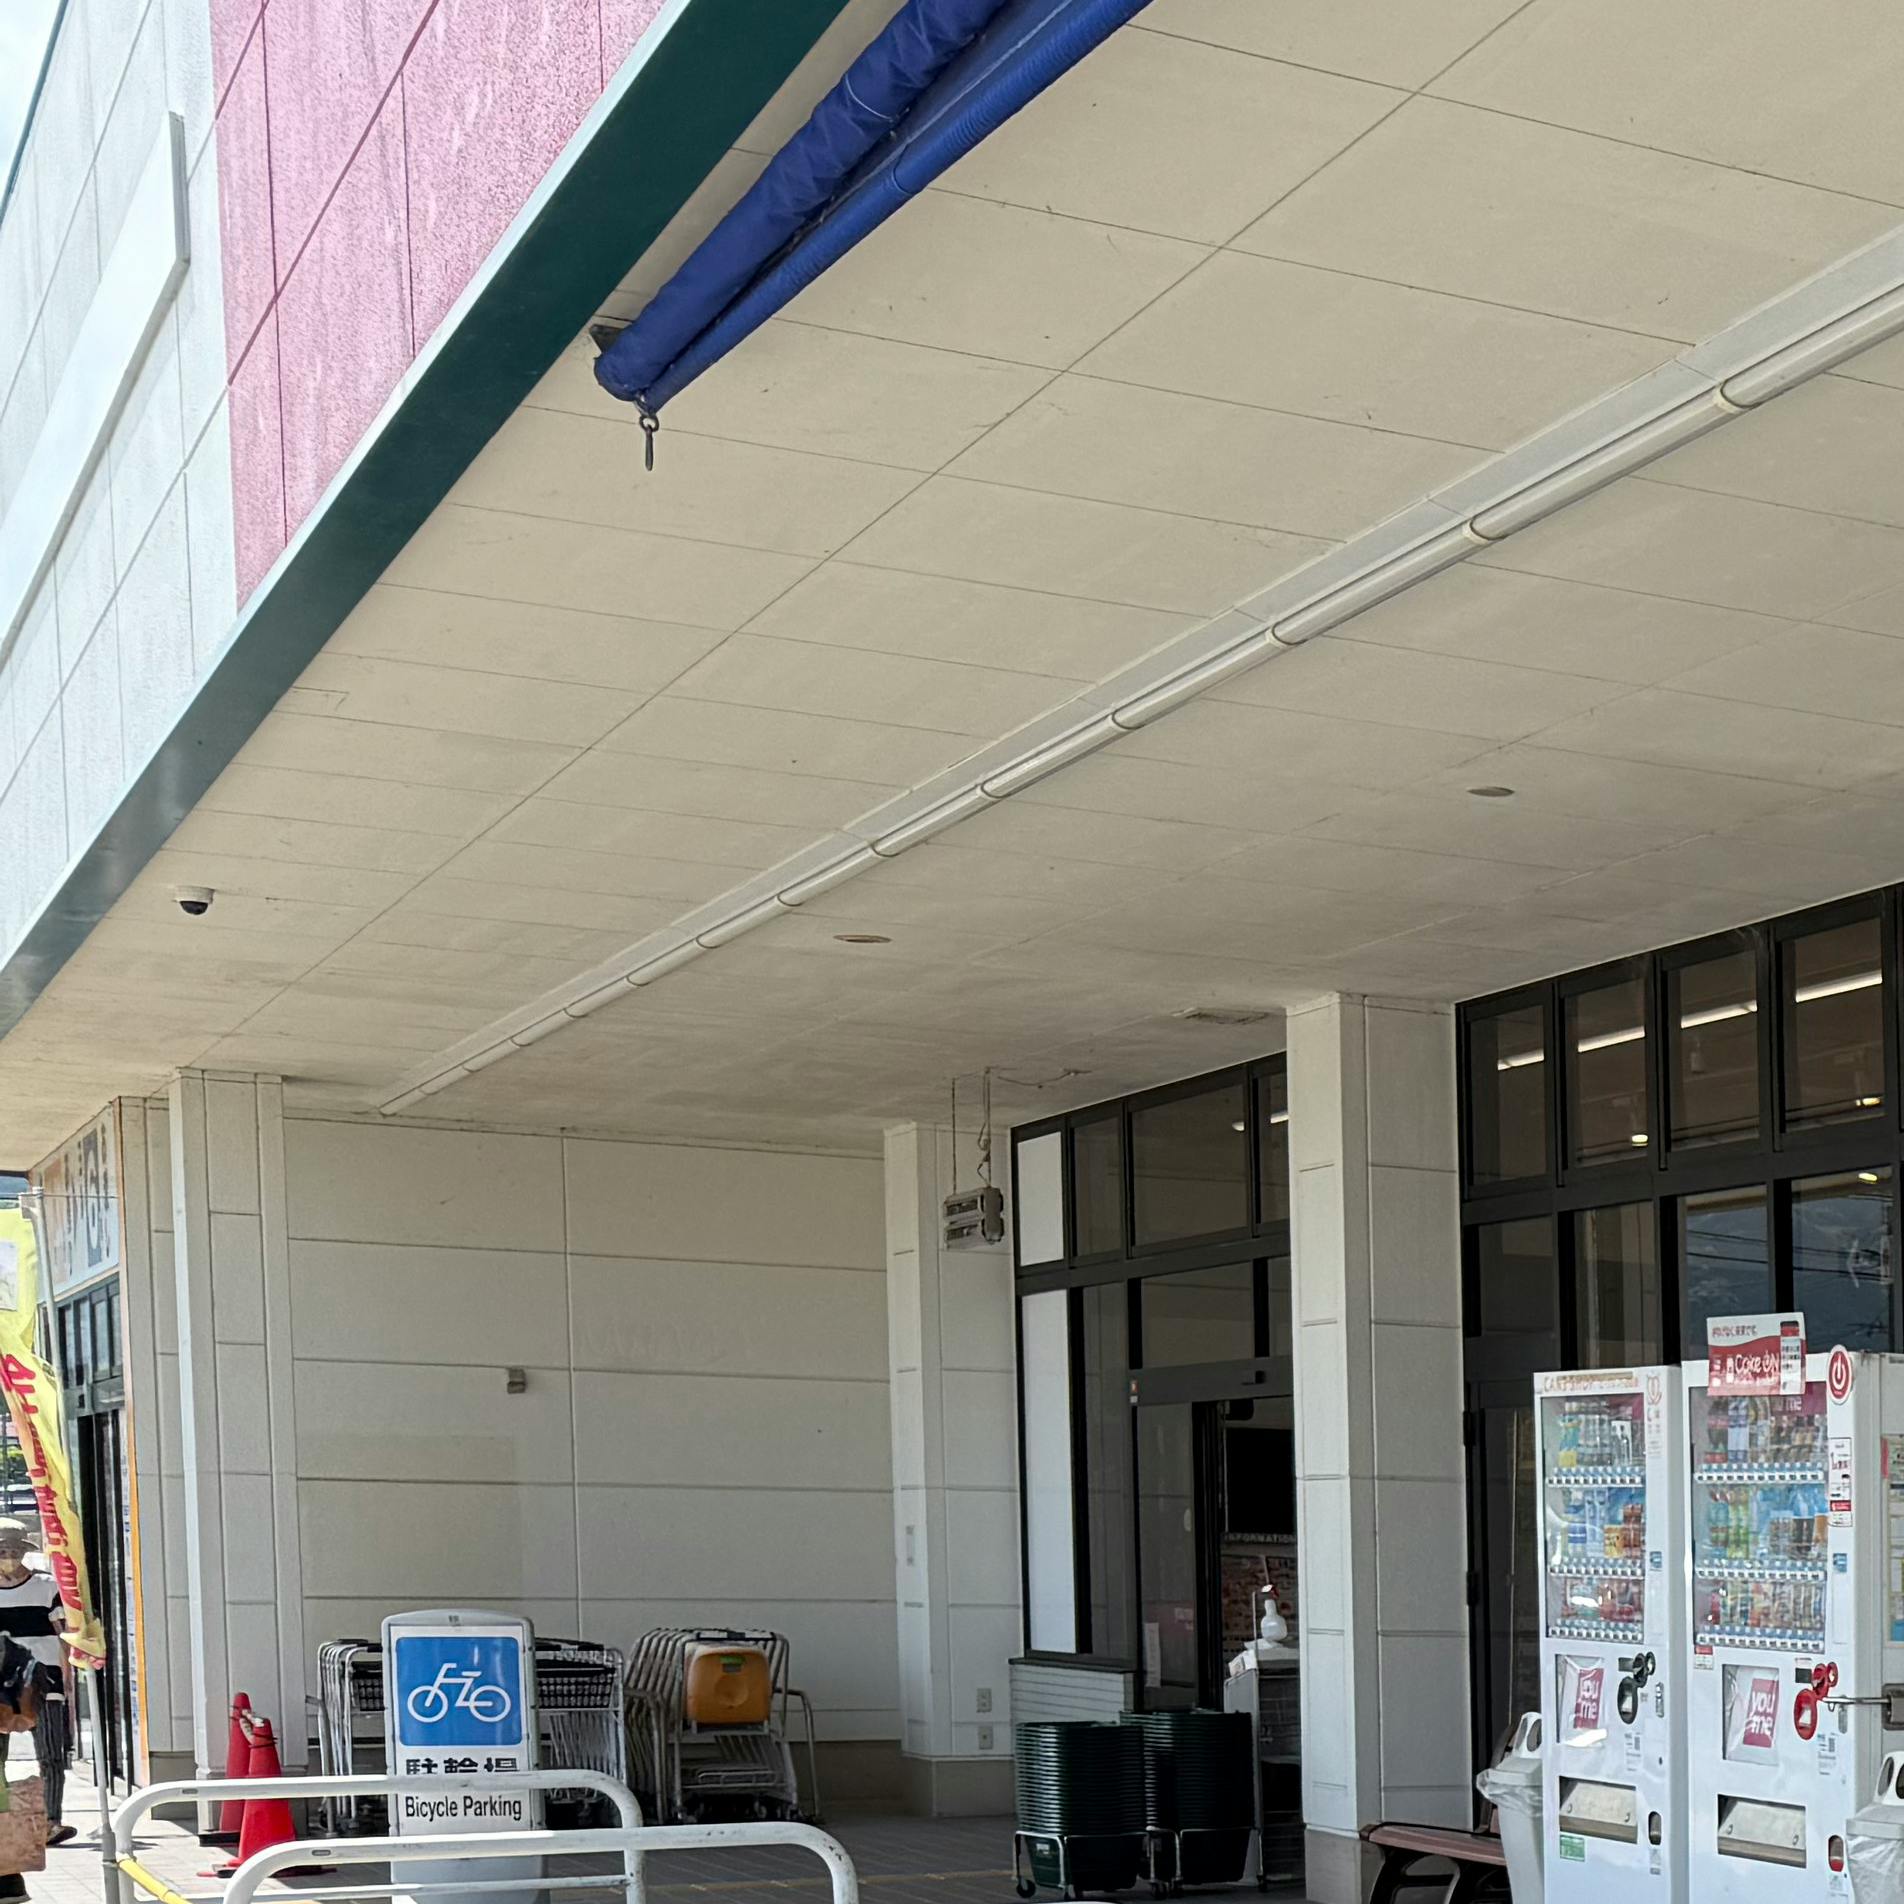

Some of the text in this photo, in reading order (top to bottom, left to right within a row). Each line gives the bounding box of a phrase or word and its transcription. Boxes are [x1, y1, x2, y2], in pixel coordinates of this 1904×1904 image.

[1750, 1689, 1776, 1715] you
[1749, 1714, 1774, 1736] me
[405, 1795, 522, 1822] Bicycle Parking
